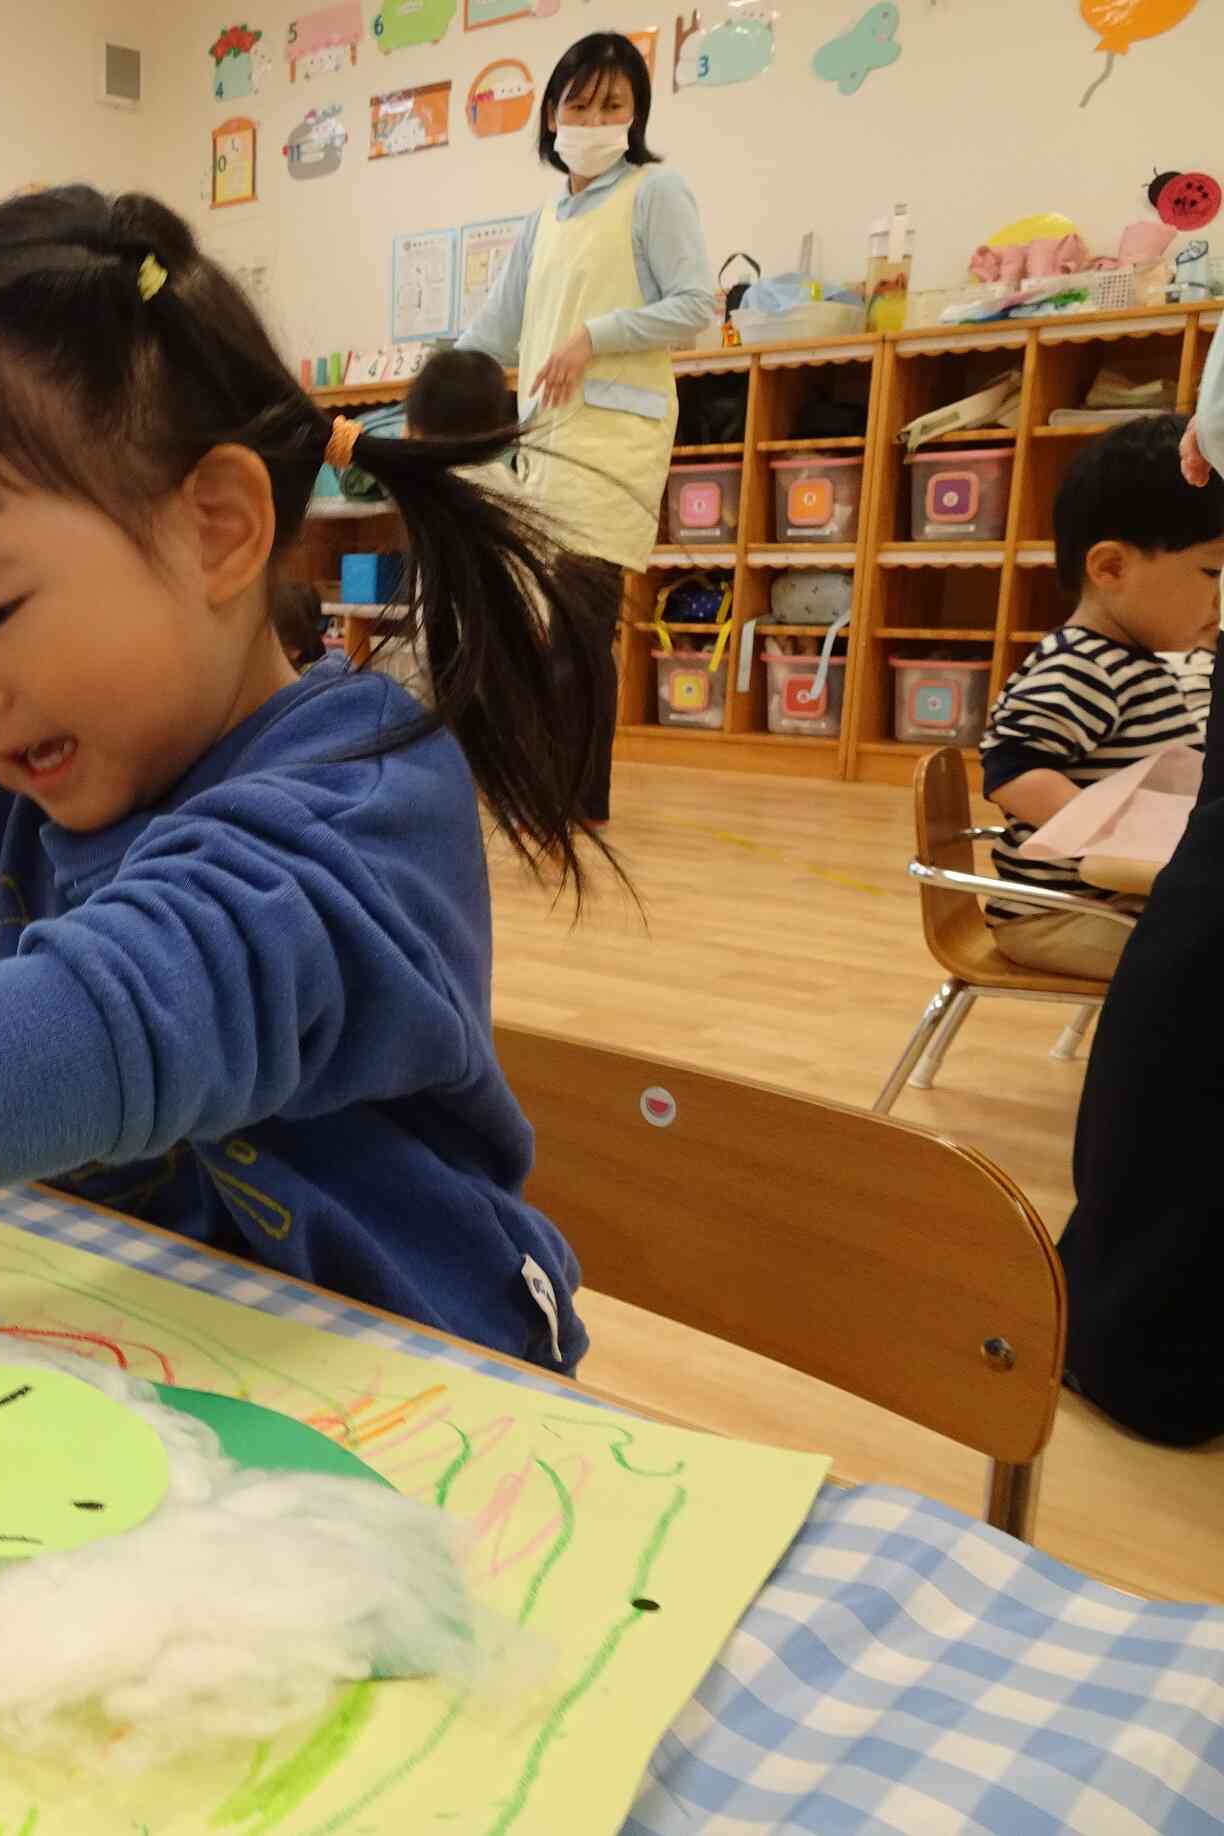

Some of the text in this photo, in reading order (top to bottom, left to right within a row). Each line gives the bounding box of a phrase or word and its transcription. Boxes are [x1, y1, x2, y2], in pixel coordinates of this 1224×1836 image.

[287, 21, 298, 44] 5
[374, 15, 384, 37] 6
[697, 55, 710, 78] 3
[215, 81, 224, 99] 4
